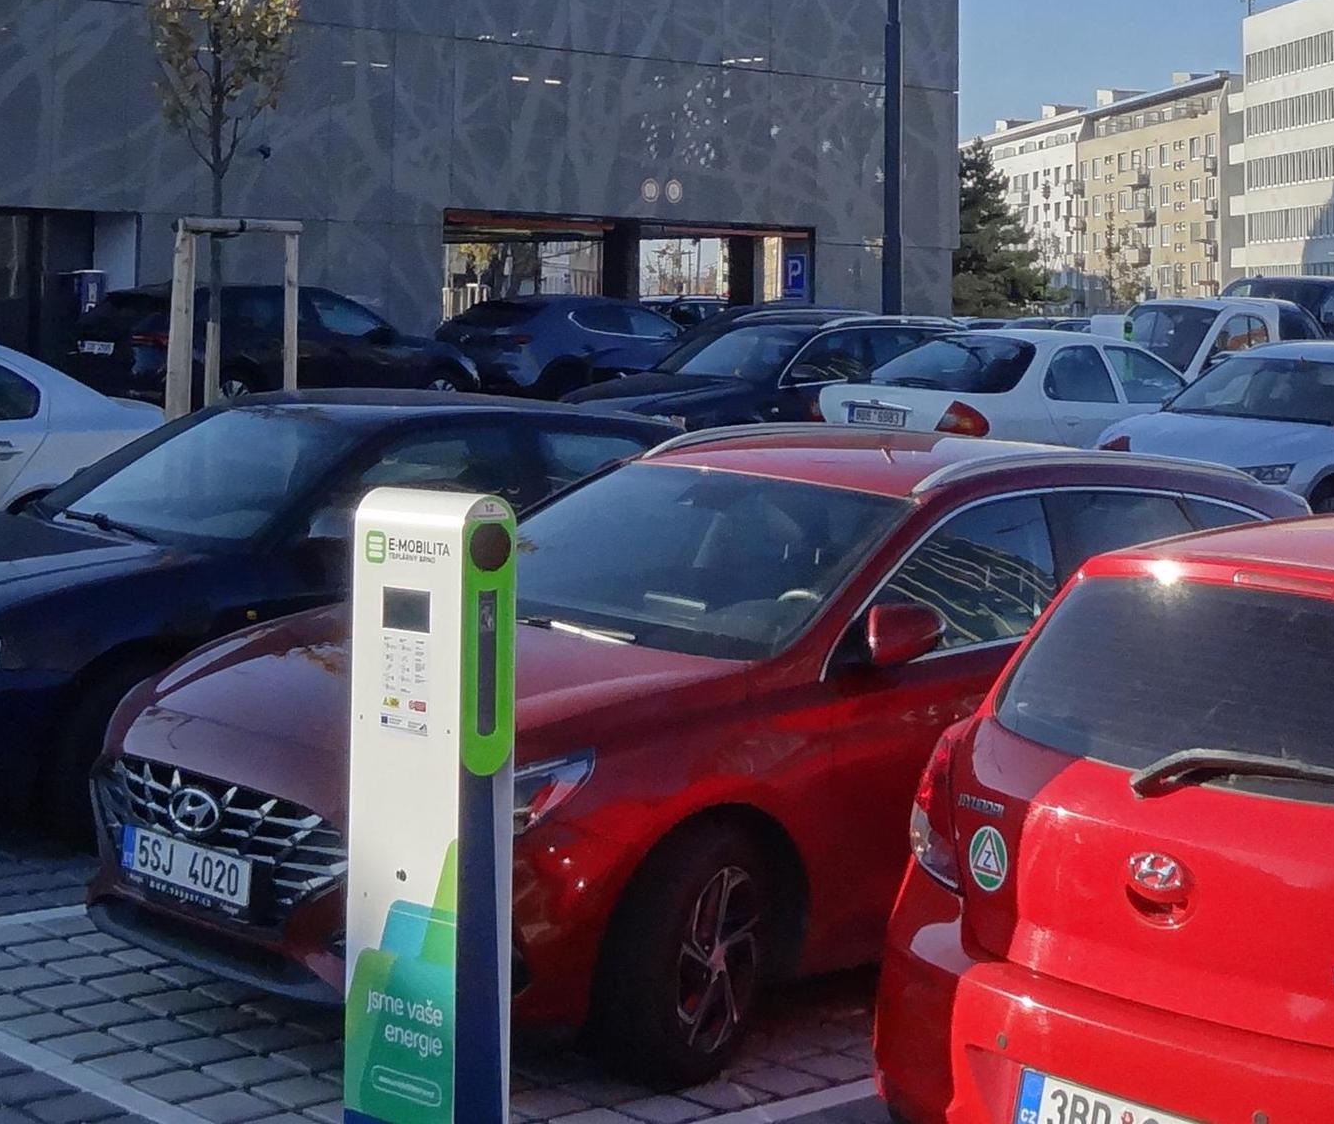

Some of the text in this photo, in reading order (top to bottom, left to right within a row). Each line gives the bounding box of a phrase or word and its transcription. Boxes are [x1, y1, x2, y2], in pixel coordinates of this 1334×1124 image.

[788, 259, 802, 287] P
[388, 537, 451, 557] E-MOBILITA
[138, 835, 175, 877] 5SJ
[188, 850, 240, 897] 4020
[983, 849, 992, 868] Z
[366, 988, 444, 1028] jsme vaše
[384, 1023, 444, 1059] energie
